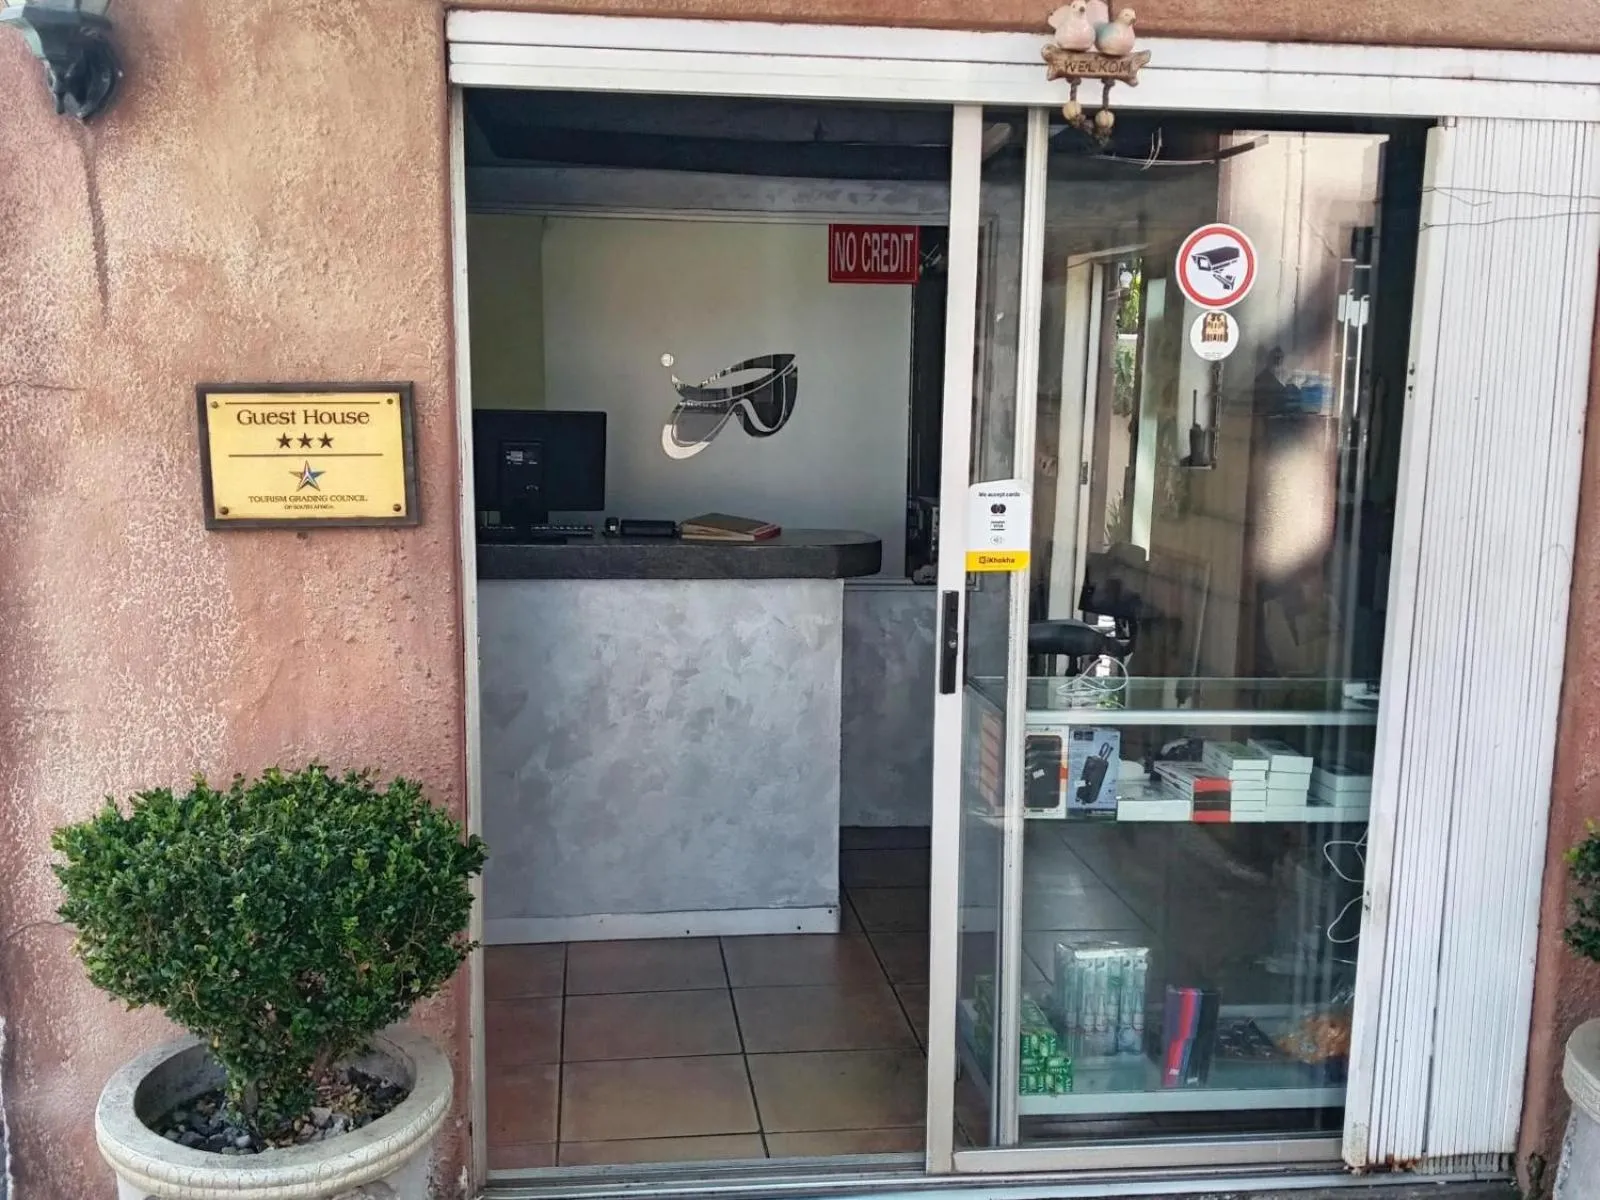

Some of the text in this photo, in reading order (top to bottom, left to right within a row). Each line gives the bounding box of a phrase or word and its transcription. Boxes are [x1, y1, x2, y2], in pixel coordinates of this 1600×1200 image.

[1064, 60, 1132, 74] WELKOM
[834, 231, 914, 273] NO CREDIT
[236, 408, 370, 426] Guest House
[248, 494, 367, 504] TOURISM GRADING COUNCIL
